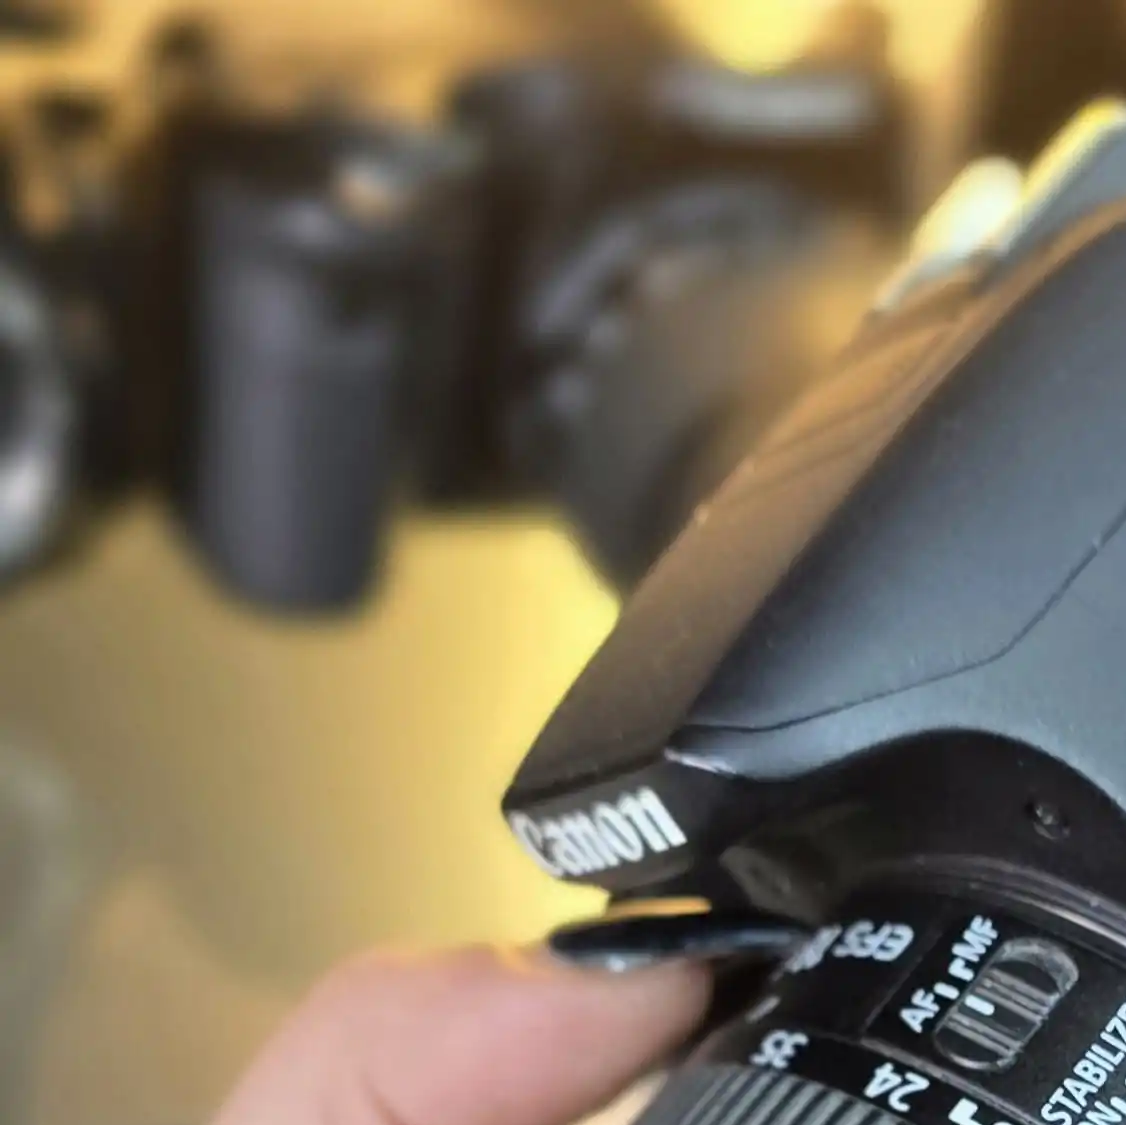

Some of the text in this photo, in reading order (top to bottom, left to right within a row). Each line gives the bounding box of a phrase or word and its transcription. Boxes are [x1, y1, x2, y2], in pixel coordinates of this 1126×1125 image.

[509, 787, 688, 877] Canon
[900, 915, 999, 1034] AF MF
[863, 1062, 930, 1112] 24
